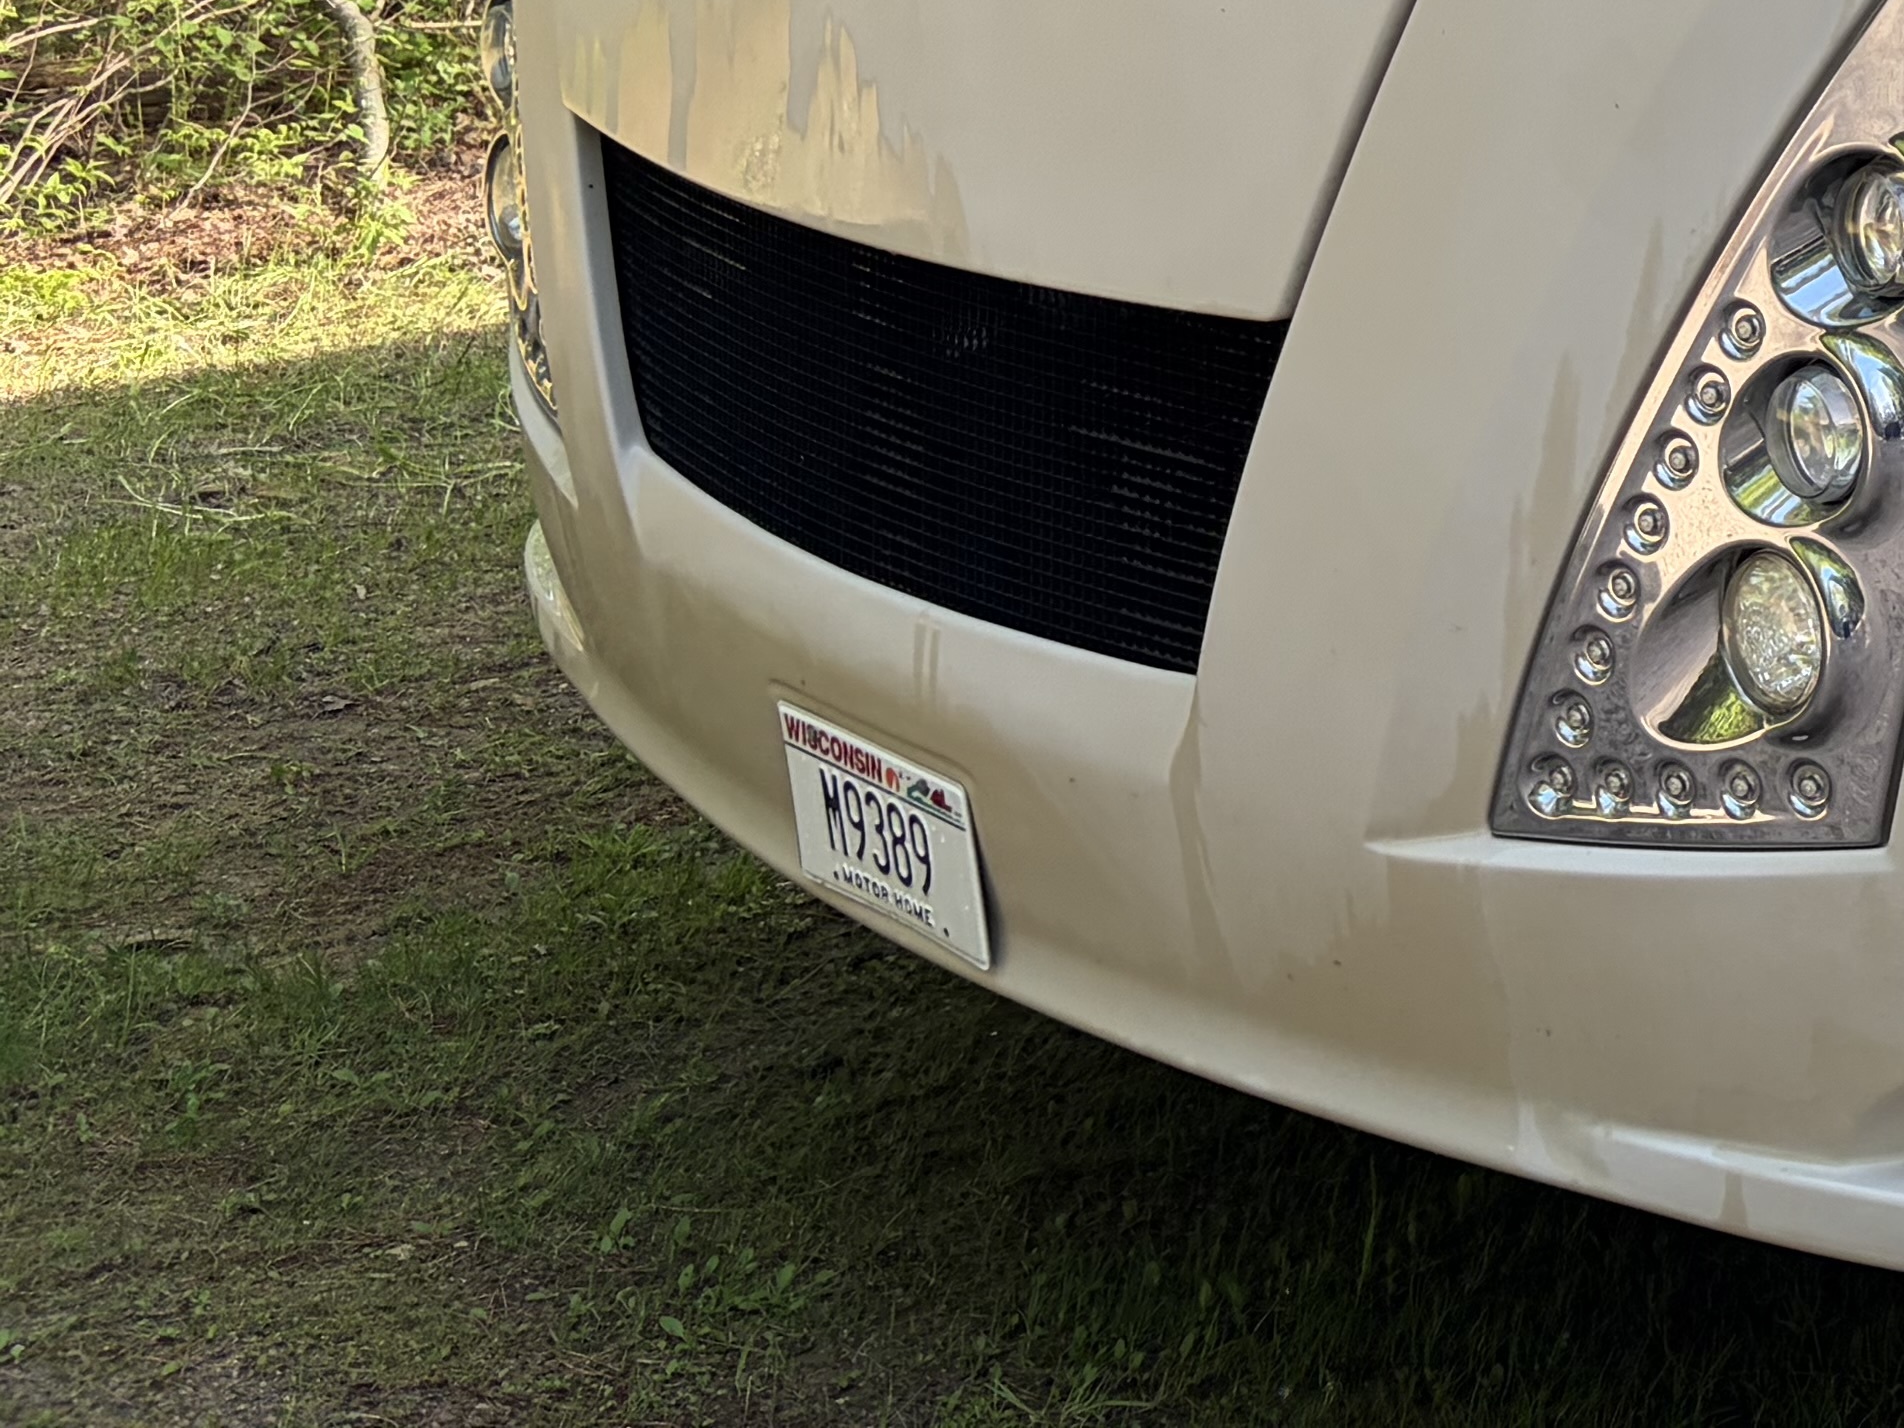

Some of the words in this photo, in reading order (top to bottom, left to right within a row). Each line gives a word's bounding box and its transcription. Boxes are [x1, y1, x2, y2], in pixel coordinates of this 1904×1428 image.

[784, 713, 883, 784] WISCONSIN
[819, 766, 932, 896] M9389
[842, 867, 889, 902] MOTOR
[893, 892, 933, 927] HOME
